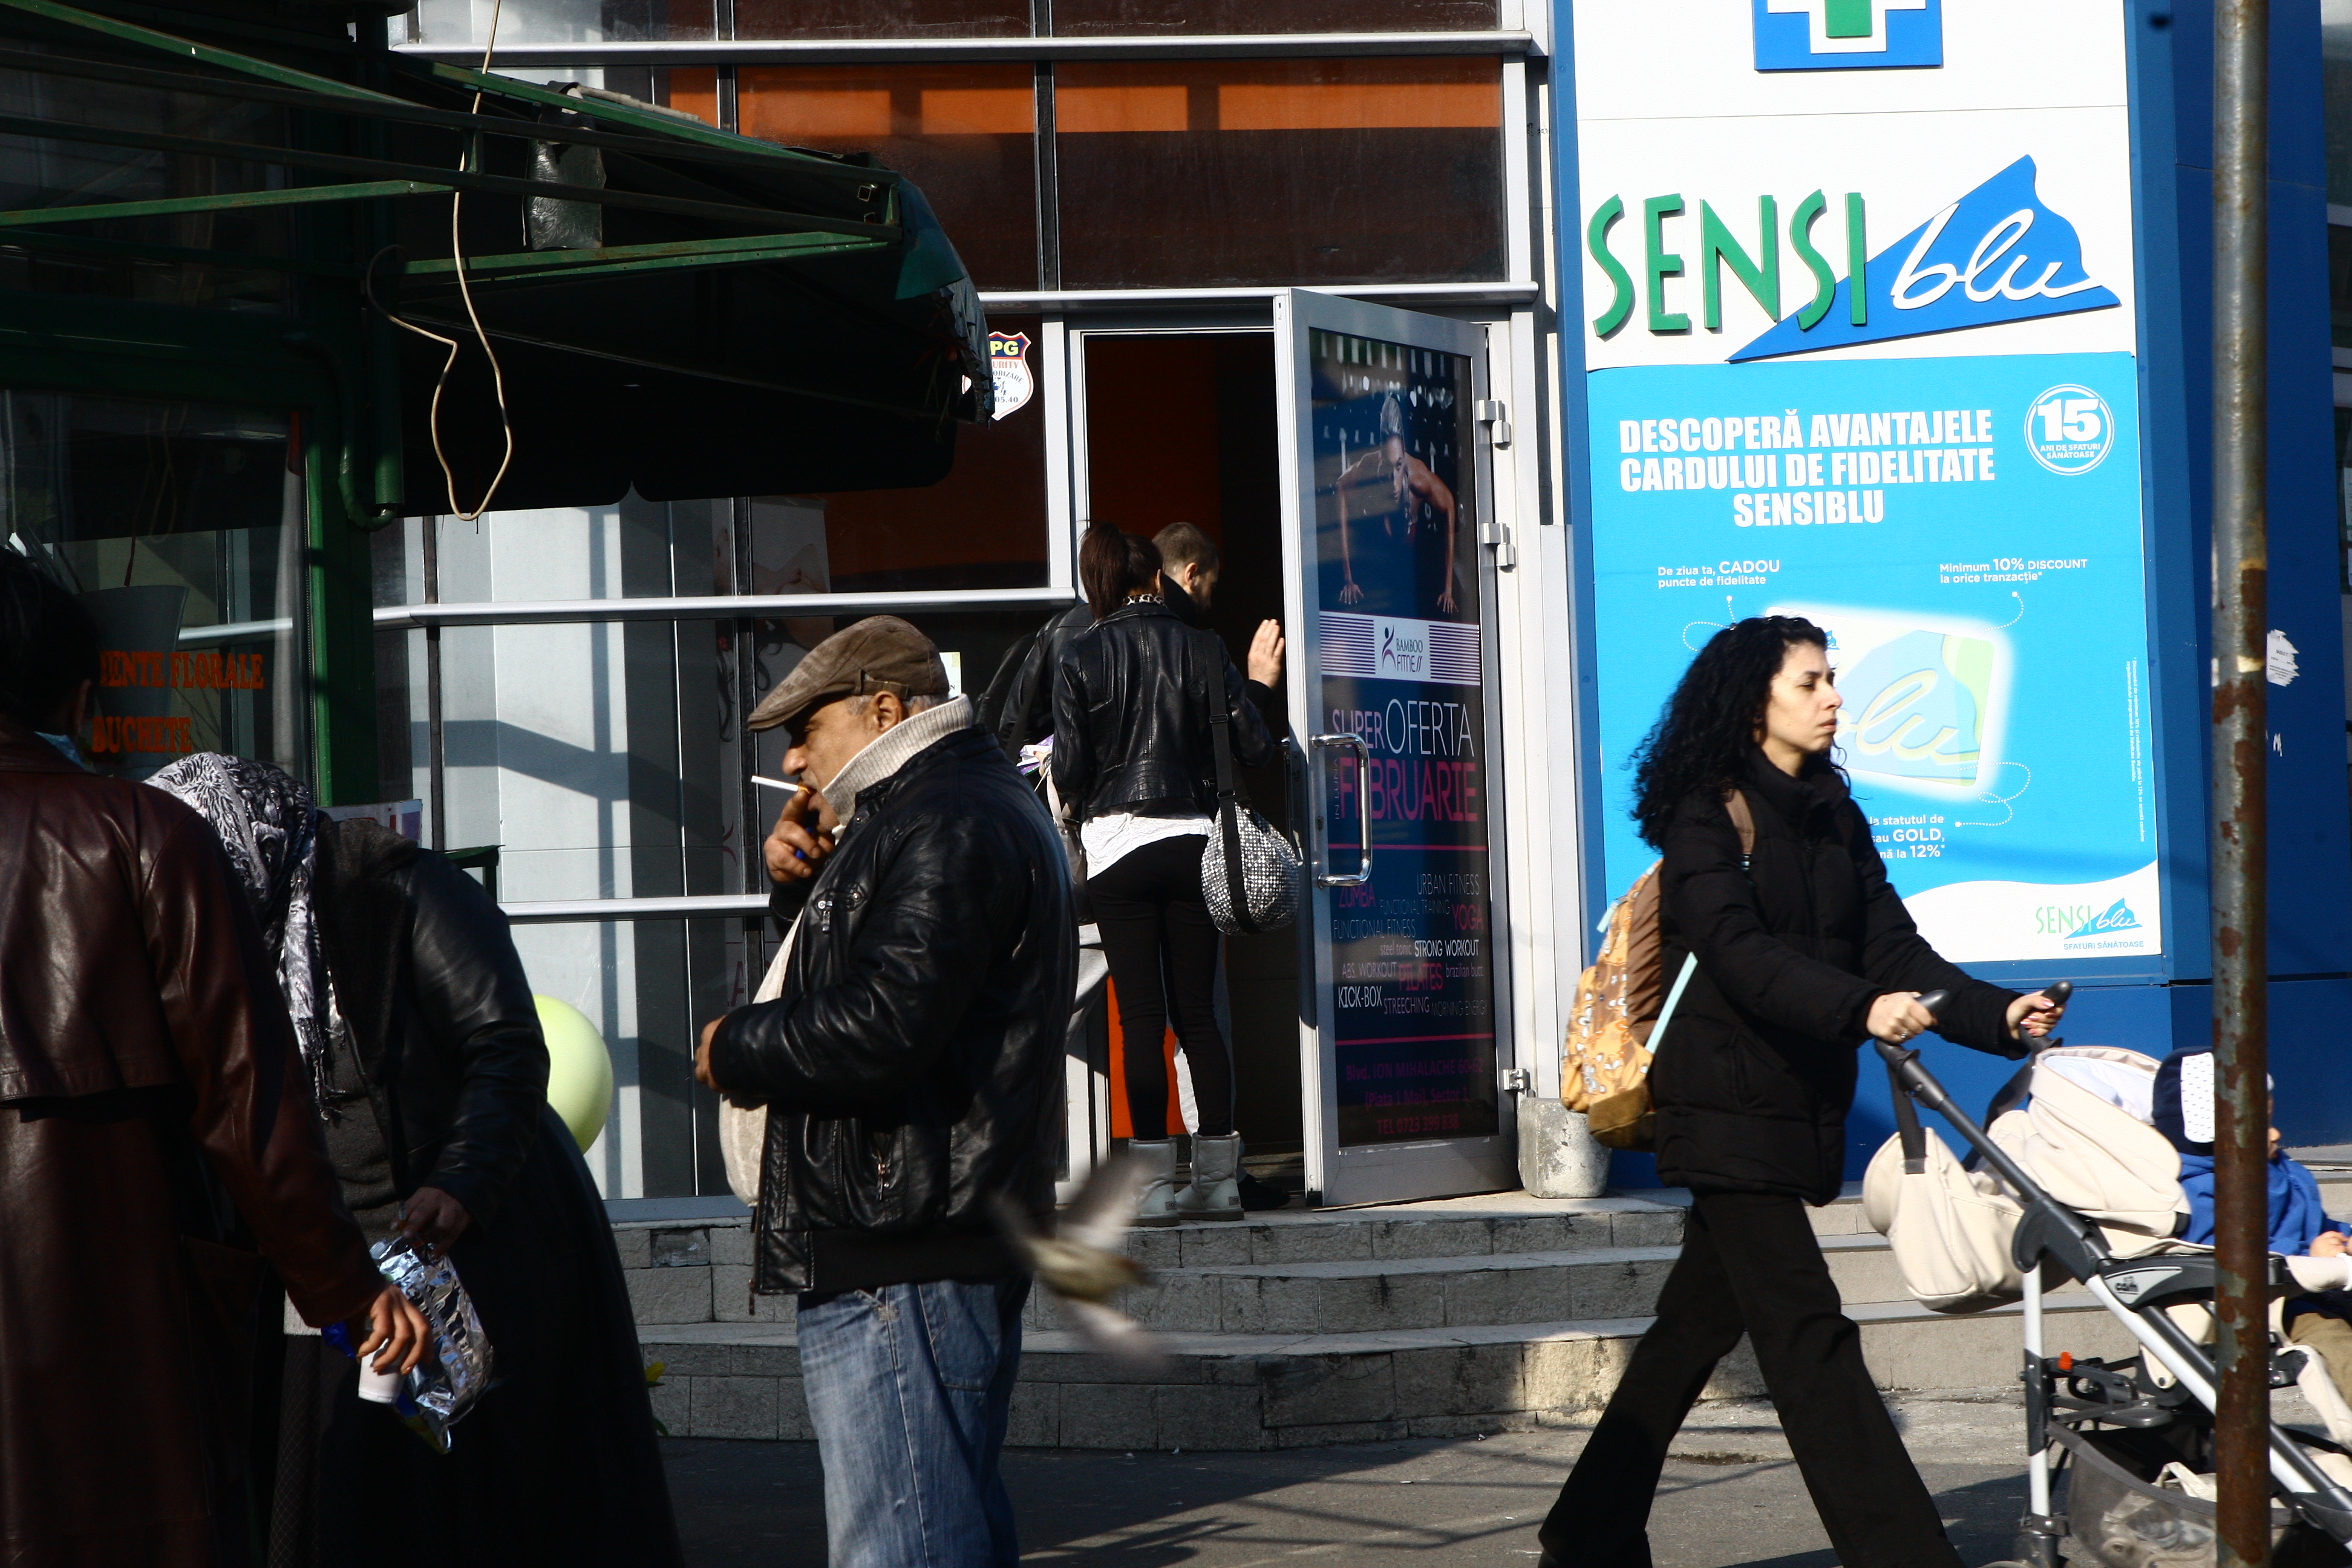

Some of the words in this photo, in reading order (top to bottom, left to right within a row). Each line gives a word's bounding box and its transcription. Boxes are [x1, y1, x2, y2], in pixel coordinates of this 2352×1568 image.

[1587, 188, 1867, 338] SENSI
[1890, 203, 2102, 310] blu
[990, 341, 1019, 356] PG
[993, 370, 1024, 384] ORIZARE
[1619, 408, 1804, 454] DESCOPERĂ
[1808, 409, 1994, 448] AVANTAJELE
[2037, 399, 2102, 442] 15
[2068, 443, 2101, 451] SFATURI
[1619, 454, 1778, 492] CARDULUI
[1785, 452, 1825, 488] DE
[1830, 447, 1996, 486] FIDELITATE
[1733, 489, 1885, 528] SENSIBLU
[1658, 566, 1673, 576] De
[1676, 566, 1699, 575] ziua
[1702, 566, 1716, 577] ta,
[1719, 560, 1780, 574] CADOU
[1939, 563, 1990, 573] Minimum
[1993, 558, 2025, 571] 10%
[2027, 558, 2088, 570] DISCOUNT
[1658, 577, 1696, 589] puncte
[1699, 577, 1714, 586] de
[1716, 575, 1766, 586] fidelitate
[1940, 574, 1950, 584] la
[1953, 573, 1981, 583] orice
[1396, 638, 1423, 653] BAMBOO
[169, 652, 264, 690] FLORALE
[91, 716, 194, 754] BUCHETE
[1332, 709, 1386, 750] SUPER
[1385, 698, 1475, 757] OFERTA
[1869, 816, 1880, 826] la
[1883, 814, 1927, 825] statutul
[1929, 814, 1944, 824] de
[1892, 828, 1945, 843] GOLD,
[1896, 849, 1907, 858] la
[1339, 883, 1377, 907] ZUMBA
[1416, 874, 1446, 896] URBAN
[1449, 874, 1480, 895] FITNESS
[1451, 904, 1485, 930] YOGA
[2036, 905, 2092, 934] SENSI
[2096, 907, 2139, 930] blu
[1333, 920, 1385, 939] FUNCTIONAL
[1387, 919, 1416, 938] FITNESS
[1414, 939, 1443, 957] STRONG
[1444, 939, 1480, 956] WORKOUT
[1359, 961, 1397, 978] WORKOUT
[1399, 962, 1444, 991] PILATES
[1338, 985, 1383, 1008] KICK-BOX
[1346, 1064, 1371, 1082] Blvd.
[1373, 1063, 1393, 1079] ION
[1396, 1060, 1456, 1078] MIHALACHE
[1377, 1119, 1395, 1135] TEL
